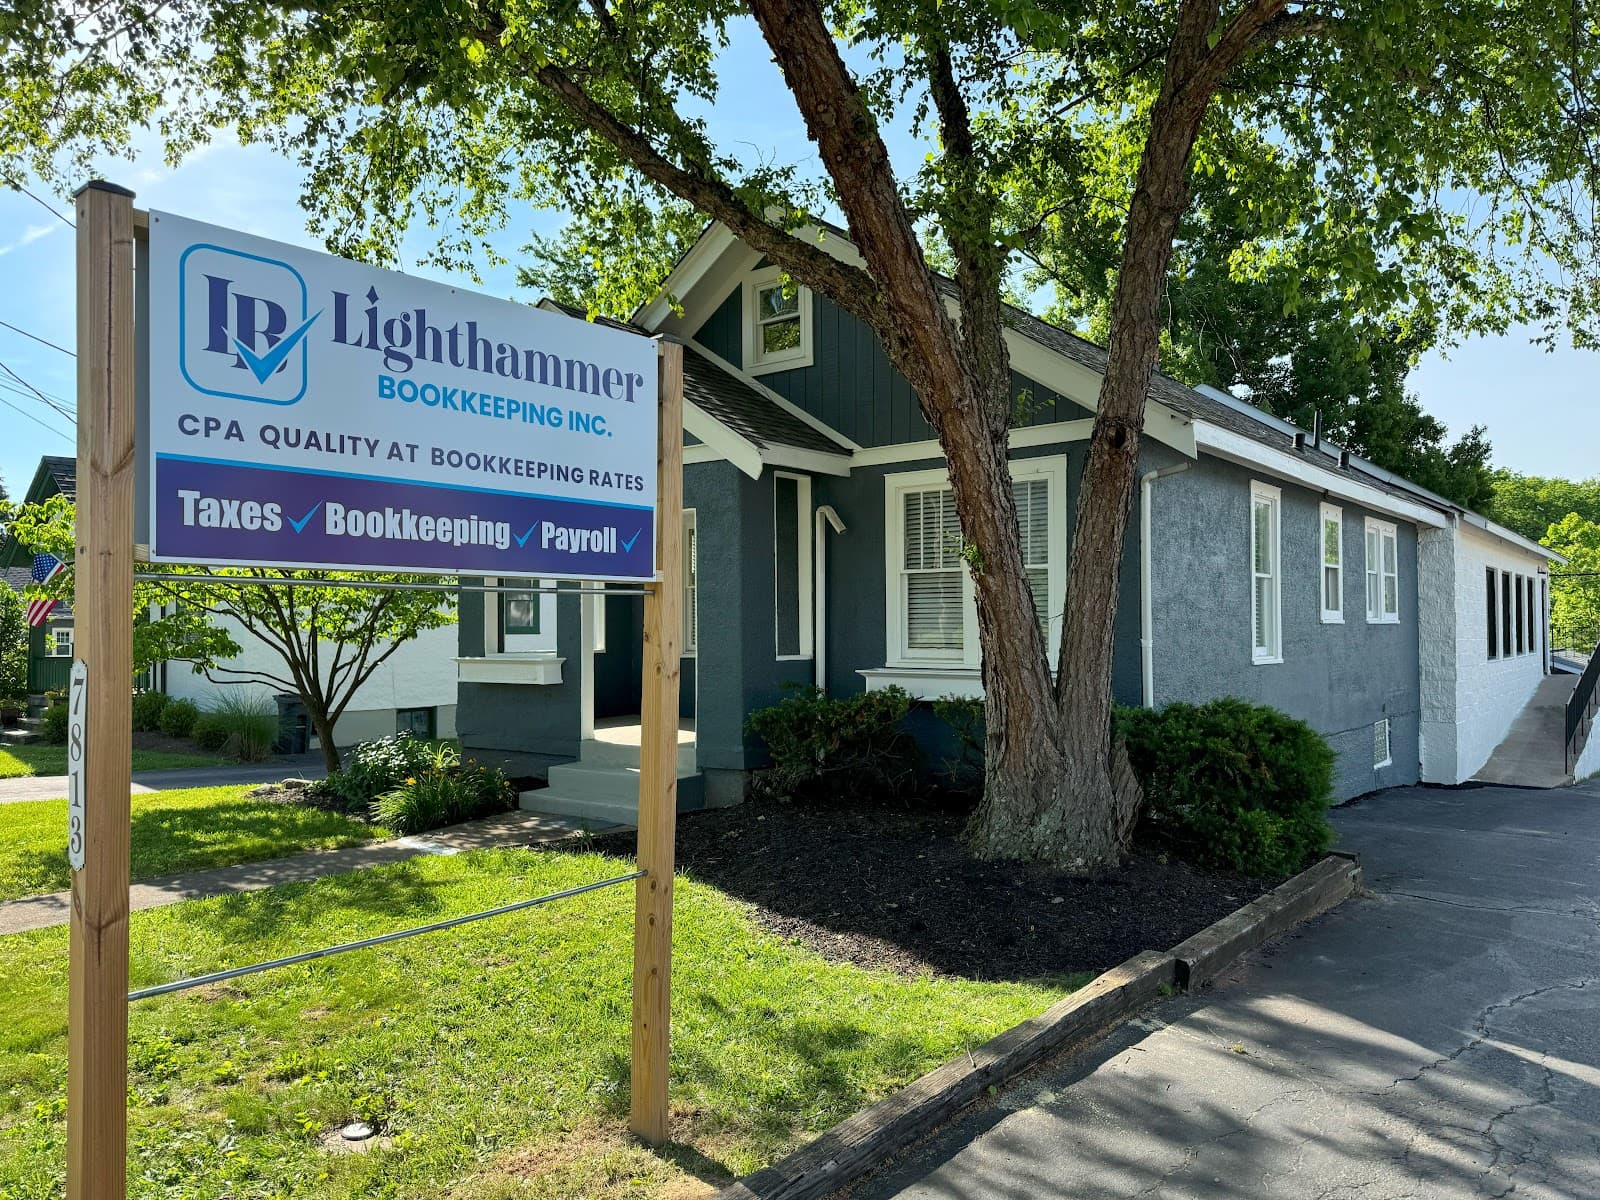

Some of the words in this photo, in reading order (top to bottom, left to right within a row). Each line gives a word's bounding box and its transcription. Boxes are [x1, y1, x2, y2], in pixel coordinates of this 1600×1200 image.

[331, 285, 644, 402] Lighthammer
[378, 375, 562, 428] BOOKKEEPING
[568, 410, 613, 437] INC.
[178, 414, 245, 442] CPA
[259, 424, 380, 458] QUALITY
[387, 442, 419, 463] AT
[431, 448, 584, 484] BOOKKEEPING
[589, 469, 644, 492] RATES
[178, 490, 282, 532] Taxes
[325, 502, 511, 551] Bookkeeping
[541, 523, 617, 554] Payroll
[70, 678, 85, 855] 7813
